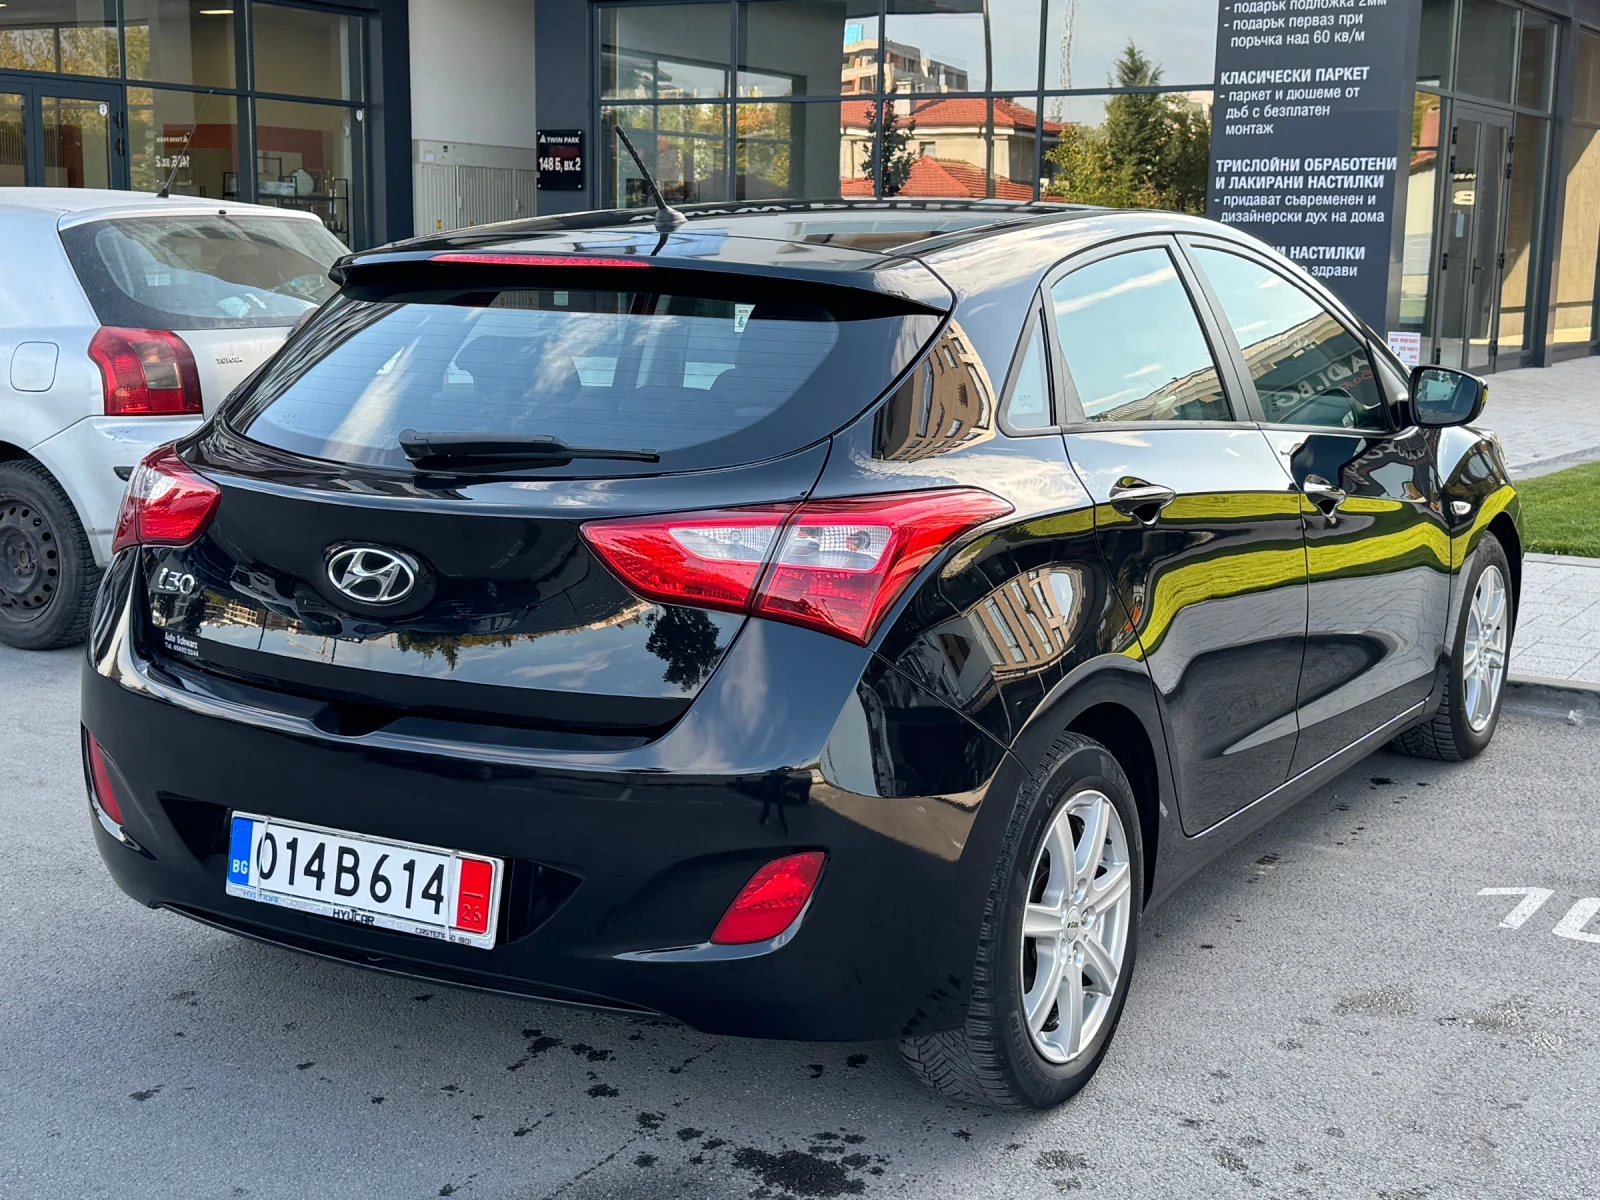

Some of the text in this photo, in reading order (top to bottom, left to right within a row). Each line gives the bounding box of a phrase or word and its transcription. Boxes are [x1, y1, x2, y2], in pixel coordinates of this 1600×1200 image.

[1234, 0, 1286, 14] подарък
[1233, 17, 1285, 31] подарък
[1289, 15, 1335, 28] перваз
[1339, 13, 1364, 27] при
[1230, 28, 1365, 49] поръчка над 60 кв/м
[1220, 66, 1370, 85] КЛАСИЧЕСКИ ПАРКЕТ
[1229, 89, 1272, 104] паркет
[1275, 89, 1284, 99] и
[1286, 88, 1341, 101] дюшеме
[1345, 86, 1361, 98] от
[1226, 104, 1331, 120] дъб с безплатен
[1225, 123, 1274, 136] монтаж
[1216, 157, 1398, 172] ТРИСЛОЙНИ ОБРАБОТЕНИ
[1215, 175, 1384, 190] И ЛАКИРАНИ НАСТИЛКИ
[1223, 195, 1282, 207] придават
[1285, 195, 1363, 207] съвременен
[1367, 194, 1376, 205] и
[1220, 211, 1385, 225] дизайнерски дух на дома
[1290, 246, 1365, 260] НАСТИЛКИ
[1311, 266, 1358, 279] здрави
[216, 355, 243, 365] TOYOTA
[158, 567, 195, 596] i30
[232, 859, 248, 875] BG
[256, 832, 445, 914] 014B614
[332, 908, 375, 926] HYUCAR
